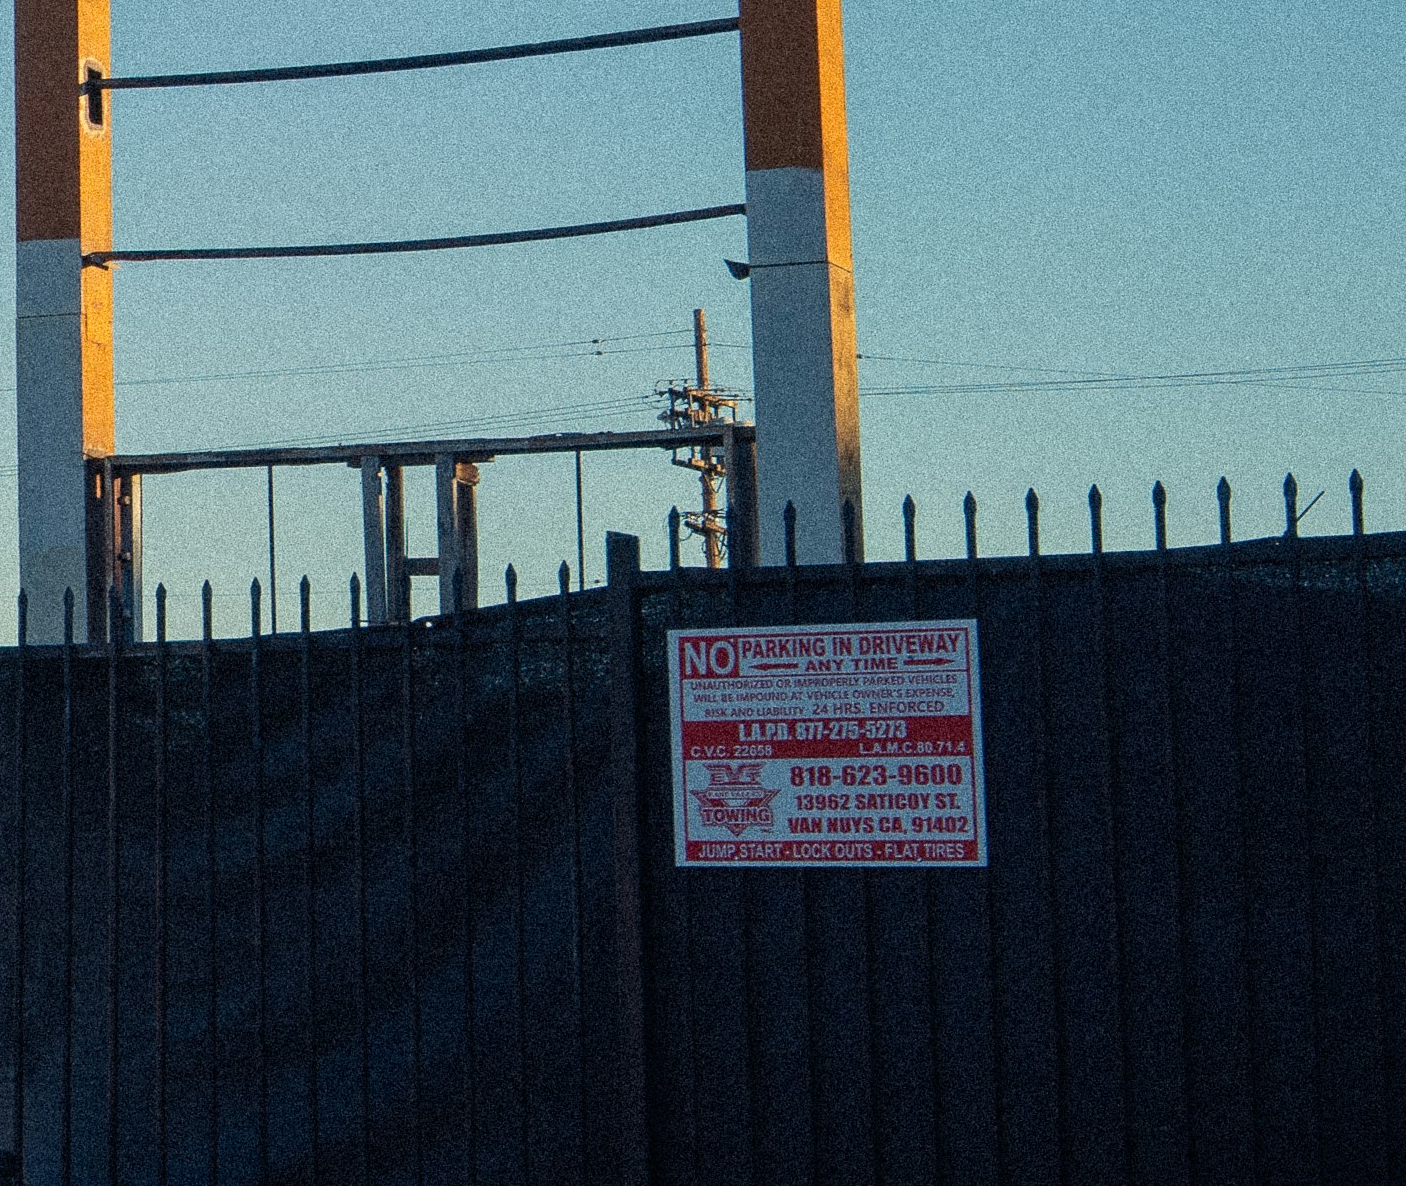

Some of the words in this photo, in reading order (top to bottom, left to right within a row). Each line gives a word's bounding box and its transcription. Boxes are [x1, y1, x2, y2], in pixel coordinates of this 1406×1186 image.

[684, 640, 736, 675] NO
[742, 637, 826, 659] PARKING
[832, 636, 852, 656] IN
[859, 633, 960, 655] DRIVEWAY
[805, 659, 844, 672] ANY
[851, 657, 899, 671] TIME
[690, 679, 773, 691] UNAUTHORIZED
[776, 678, 791, 688] OR
[794, 677, 860, 688] IMPROPERLY
[863, 676, 905, 686] PARKED
[908, 674, 958, 685] VEHICLES
[694, 693, 718, 703] WILL
[721, 693, 734, 702] BE
[736, 692, 786, 702] IMPOUND
[790, 691, 803, 701] AT
[807, 690, 849, 700] VEHICLE
[852, 688, 902, 699] OWNER'S
[705, 708, 727, 718] RISK
[731, 707, 754, 717] AND
[812, 704, 829, 715] 24
[833, 703, 865, 715] HRS.
[870, 700, 945, 713] ENFORCED
[738, 723, 792, 742] L.A.P.D.
[795, 720, 907, 740] 877-275-5273
[690, 745, 729, 757] C.V.C.
[733, 744, 773, 756] 22658
[790, 763, 963, 787] 818-623-9600
[795, 794, 850, 811] 13962
[854, 793, 930, 811] SATICOY
[934, 792, 961, 810] ST.
[701, 808, 771, 823] TOWING
[787, 817, 822, 833] VAN
[827, 817, 874, 833] NUYS
[878, 816, 907, 834] CA,
[912, 816, 969, 833] 91402
[698, 844, 735, 858] JUMP
[739, 843, 783, 858] START
[792, 843, 831, 858] LOCK
[835, 843, 873, 858] OUTS
[884, 843, 918, 858] FLAT
[924, 842, 965, 858] TIRES
